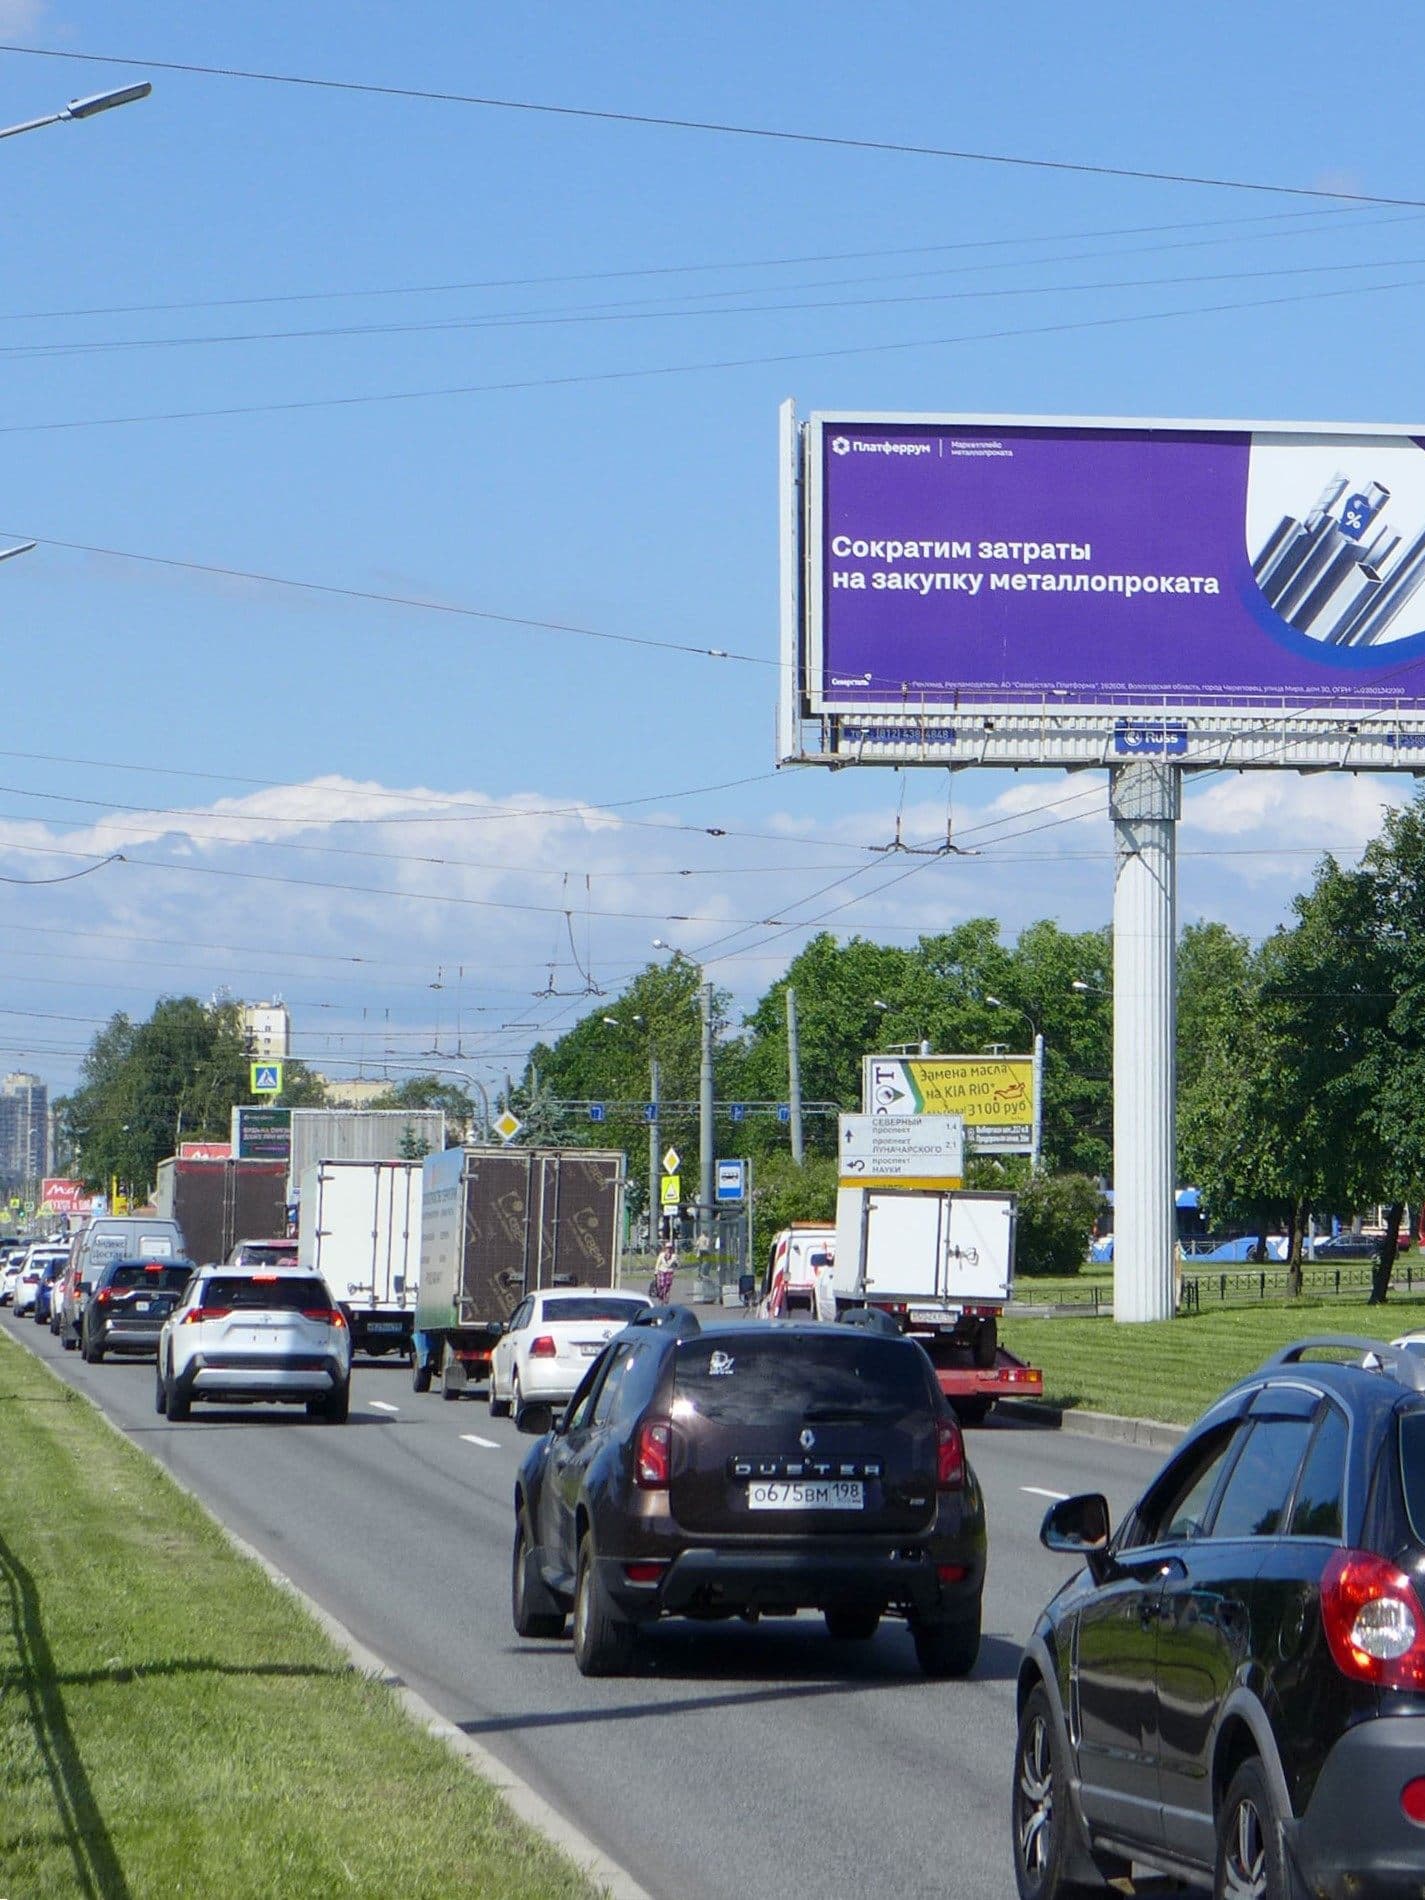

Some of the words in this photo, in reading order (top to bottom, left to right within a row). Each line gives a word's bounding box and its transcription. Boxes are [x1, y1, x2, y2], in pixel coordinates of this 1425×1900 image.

[852, 441, 931, 456] Платферрум
[951, 449, 1014, 458] металлопроката
[832, 535, 971, 562] Сократим
[978, 539, 1091, 564] затраты
[832, 570, 866, 589] на
[872, 571, 984, 595] закупку
[990, 572, 1220, 597] металлопроката
[1145, 731, 1179, 744] Russ
[920, 1066, 967, 1082] Замена
[970, 1064, 1008, 1077] масла
[926, 1089, 942, 1099] на
[945, 1085, 965, 1099] KIA
[968, 1102, 1000, 1117] 3100
[1004, 1100, 1027, 1116] руб
[872, 1118, 922, 1126] СЕВЕРНЫЙ
[872, 1145, 942, 1154] ЛУНАЧАРСКОГО
[735, 1464, 880, 1475] DUSTER
